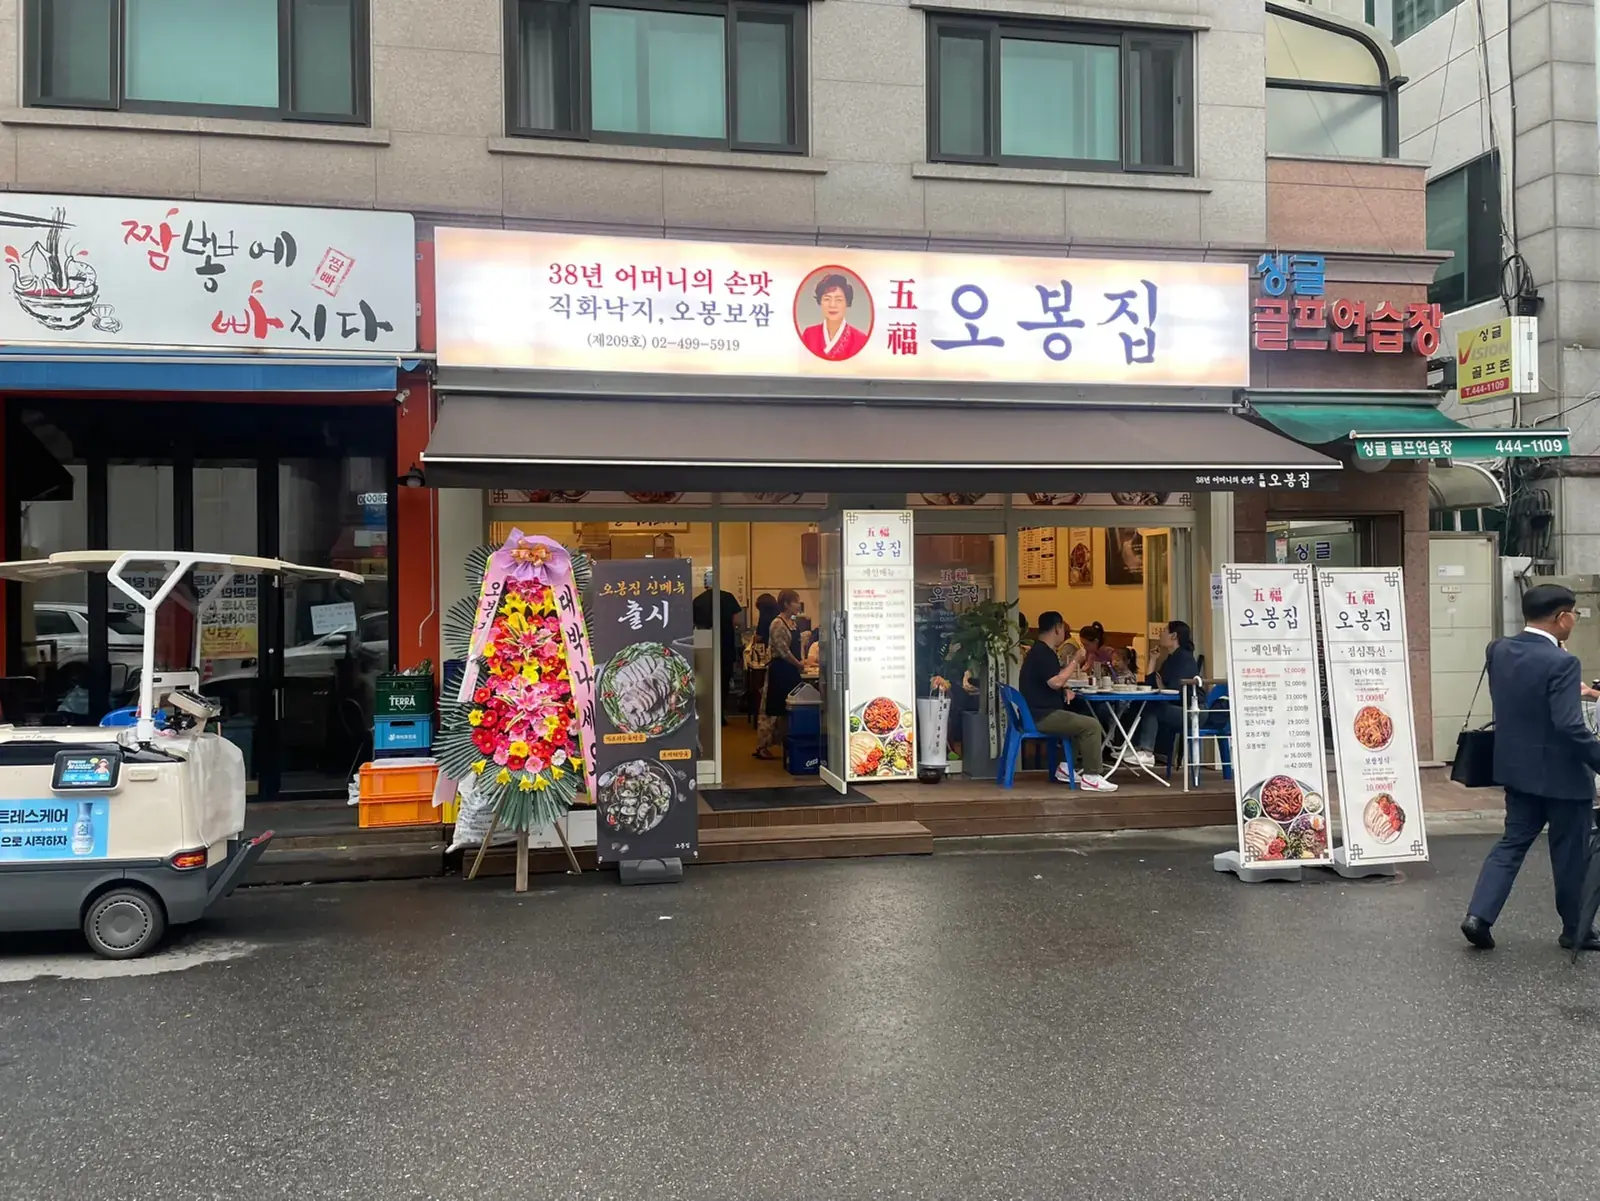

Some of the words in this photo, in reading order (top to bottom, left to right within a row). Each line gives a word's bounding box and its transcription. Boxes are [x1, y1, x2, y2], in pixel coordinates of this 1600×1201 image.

[121, 217, 298, 293] 짬뽕에
[549, 263, 604, 289] 38년
[615, 264, 714, 295] 어머니의
[724, 269, 773, 298] 손맛
[1256, 252, 1326, 298] 싱글
[211, 295, 394, 343] 빠지다
[548, 293, 664, 325] 직화낙지,
[670, 299, 774, 328] 오봉보쌈
[887, 278, 918, 356] 五福
[930, 278, 1158, 366] 오봉집
[1253, 298, 1445, 357] 골프연습장
[587, 333, 647, 350] (제209호)
[652, 336, 741, 352] 02-499-5919
[1479, 325, 1502, 342] 싱글
[1472, 358, 1511, 380] 골프존
[1464, 380, 1505, 396] T.444-1109
[1362, 441, 1387, 457] 싱글
[1391, 440, 1453, 456] 골프연습장
[1495, 439, 1563, 454] 444-1109
[1195, 475, 1211, 484] 38년
[1212, 475, 1239, 484] 어머니의
[1268, 471, 1310, 489] 오봉집
[855, 539, 901, 558] 오봉집
[1294, 541, 1331, 561] 싱글
[599, 580, 641, 596] 오봉집
[928, 584, 979, 605] 오봉집
[1253, 587, 1283, 603] 五福
[1345, 590, 1376, 605] 五福
[617, 599, 669, 630] 출시
[1239, 605, 1299, 630] 오봉집
[1335, 608, 1391, 632] 오봉집
[1251, 643, 1293, 656] 메인메뉴
[1347, 645, 1387, 657] 점심특선
[389, 694, 416, 706] TERRA
[1, 835, 22, 847] 으로
[24, 835, 68, 847] 시작하자
